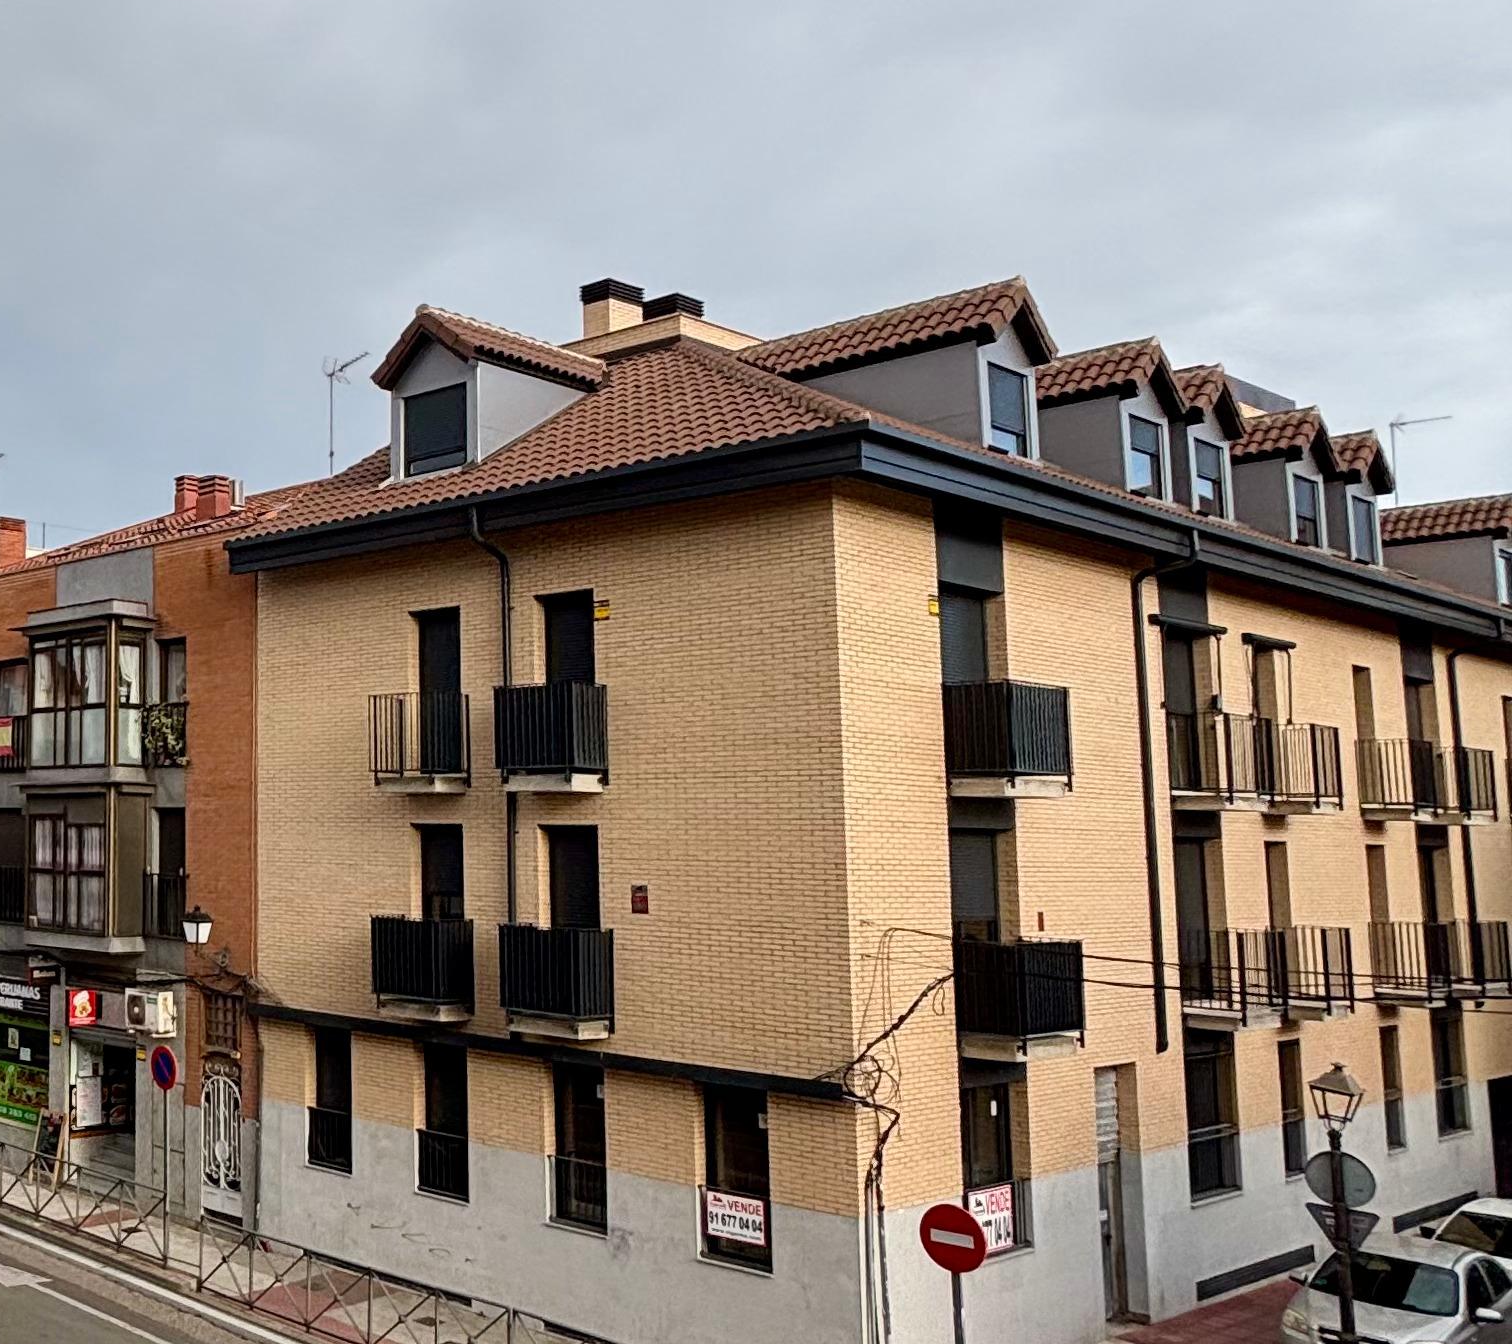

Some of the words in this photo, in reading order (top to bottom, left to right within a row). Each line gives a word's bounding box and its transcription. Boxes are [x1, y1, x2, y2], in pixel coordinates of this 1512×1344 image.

[727, 1199, 762, 1216] VENDE
[985, 1191, 1010, 1215] VENDE
[709, 1211, 718, 1225] 91
[721, 1213, 736, 1228] 677
[739, 1216, 750, 1230] 04
[752, 1219, 763, 1233] 04
